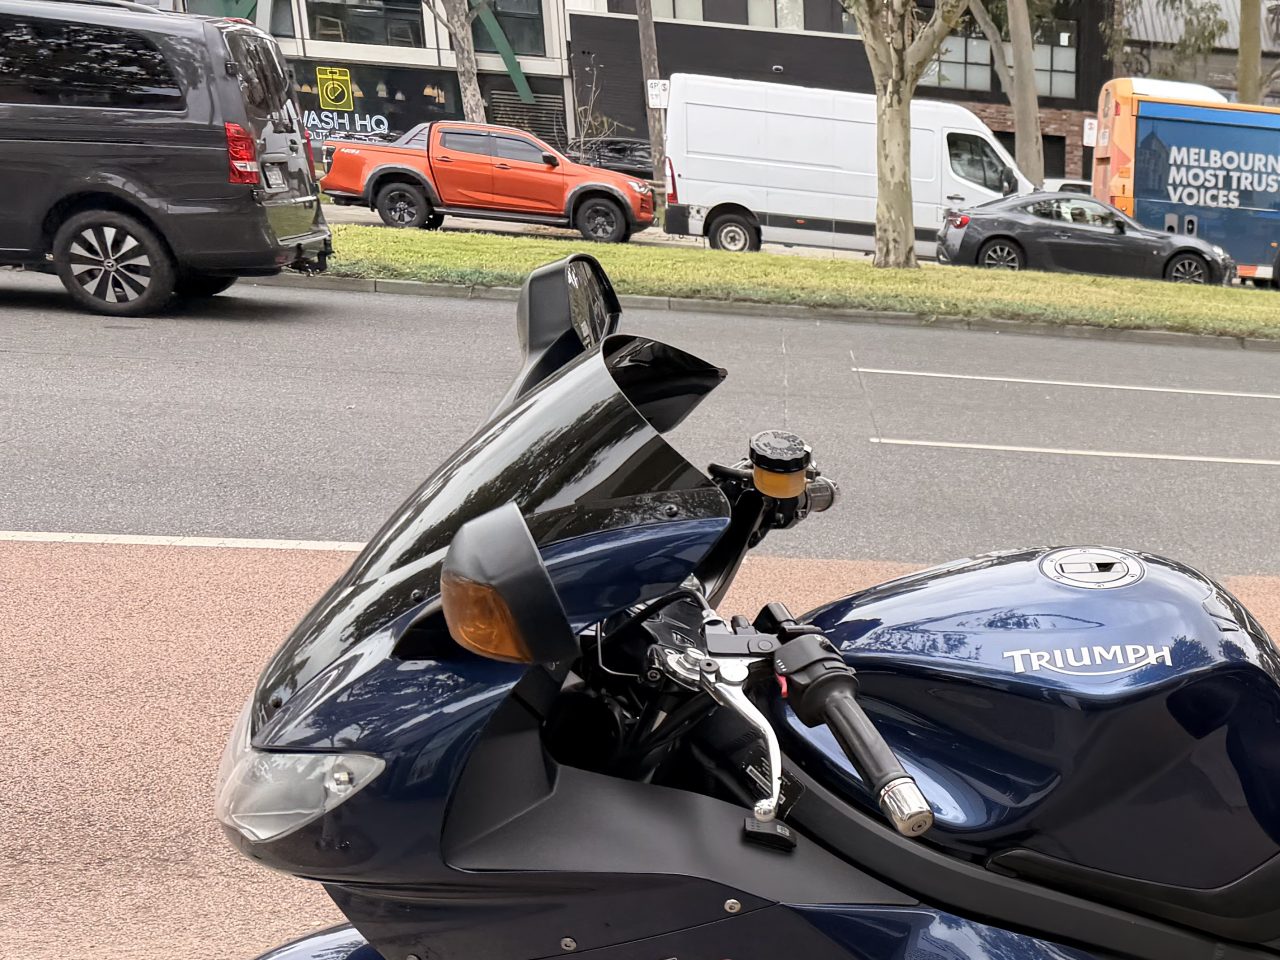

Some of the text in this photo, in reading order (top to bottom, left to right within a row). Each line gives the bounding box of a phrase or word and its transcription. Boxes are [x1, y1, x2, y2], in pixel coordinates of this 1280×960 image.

[354, 113, 389, 134] HQ
[1168, 166, 1227, 190] MOST
[1167, 185, 1240, 210] VOICES
[1003, 644, 1173, 676] TRIUMPH
